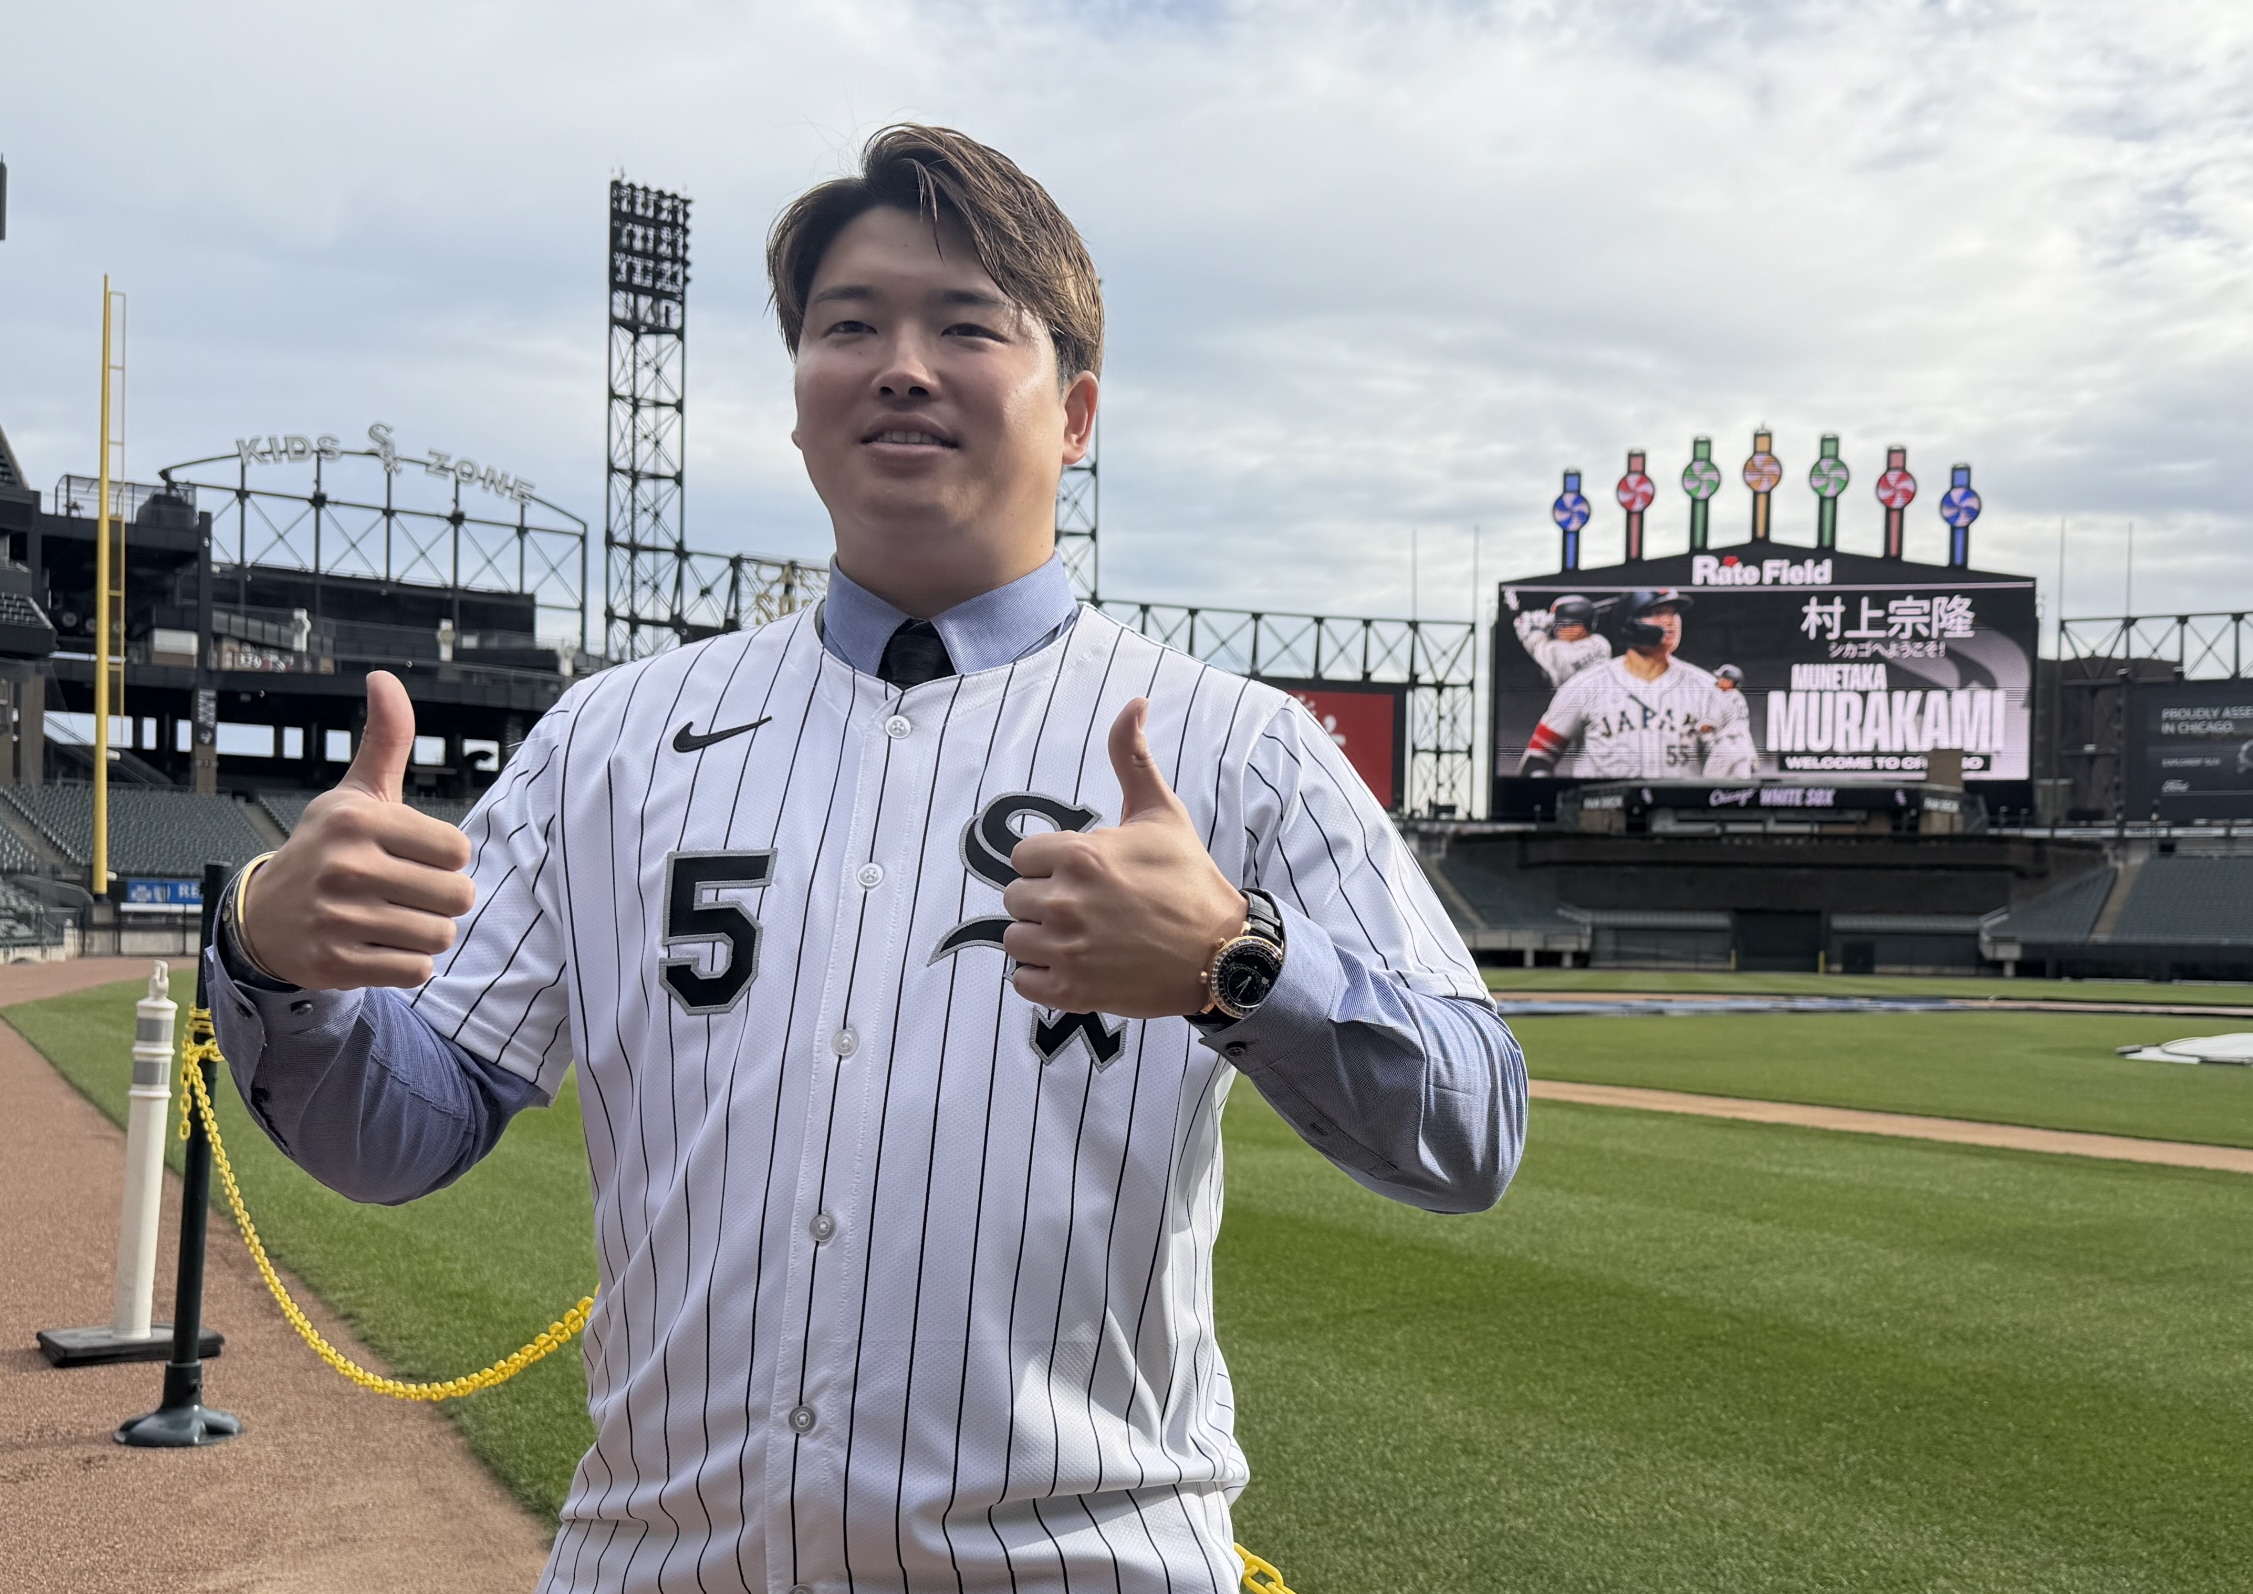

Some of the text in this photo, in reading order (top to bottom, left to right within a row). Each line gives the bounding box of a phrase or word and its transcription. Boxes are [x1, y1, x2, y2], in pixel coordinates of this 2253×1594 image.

[236, 435, 342, 464] KIDS
[425, 448, 535, 507] ZONE
[1692, 555, 1833, 585] Rate Field
[1801, 595, 1976, 640] 村上宗隆
[1791, 663, 1888, 691] MUNETAKA
[1767, 690, 2006, 752] MURAKAMI
[2161, 721, 2176, 734] IN
[2162, 707, 2221, 720] PROUDLY
[1785, 756, 1874, 769] WELCOME
[1874, 756, 1900, 769] TO
[1760, 788, 1804, 807] WHITE
[1805, 788, 1835, 807] SOX
[659, 848, 778, 1016] 5
